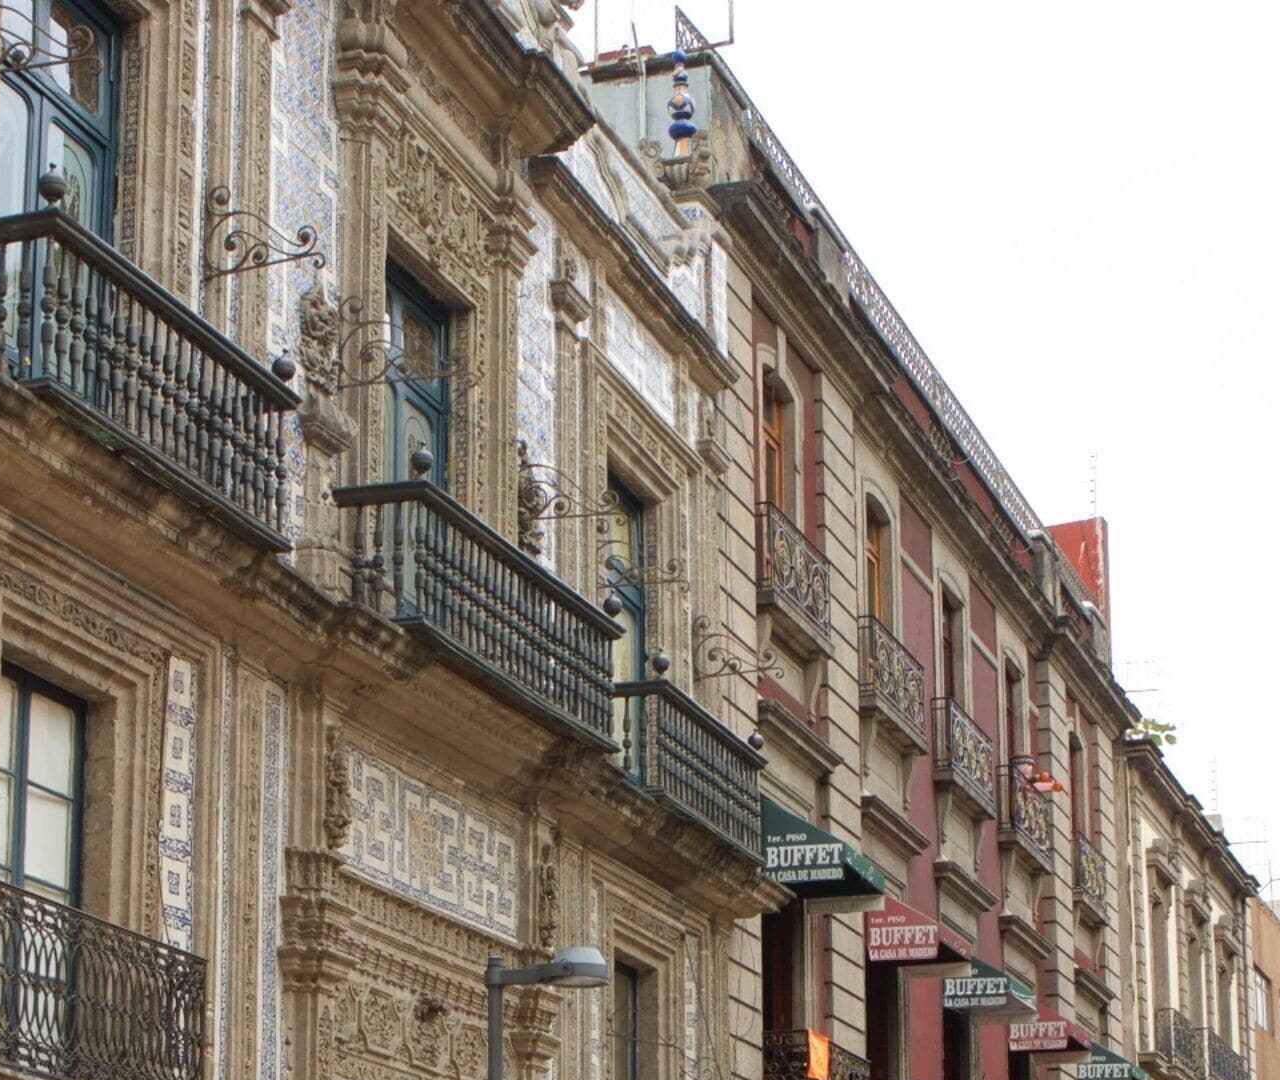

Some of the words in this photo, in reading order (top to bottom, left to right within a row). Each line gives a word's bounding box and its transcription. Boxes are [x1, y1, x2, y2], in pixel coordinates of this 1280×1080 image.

[786, 833, 807, 842] PISO
[766, 843, 844, 868] BUFFET
[777, 870, 797, 881] CASA
[798, 869, 809, 880] DE
[810, 867, 844, 880] MADERO
[887, 915, 906, 923] PISO
[870, 925, 938, 946] BUFFET
[870, 949, 879, 959] LA
[880, 948, 897, 958] CASA
[898, 948, 907, 958] DE
[908, 946, 937, 957] MADERO
[944, 977, 1008, 995] BUFFET
[1009, 1021, 1067, 1039] BUFFET
[1078, 1063, 1131, 1079] BUFFET
